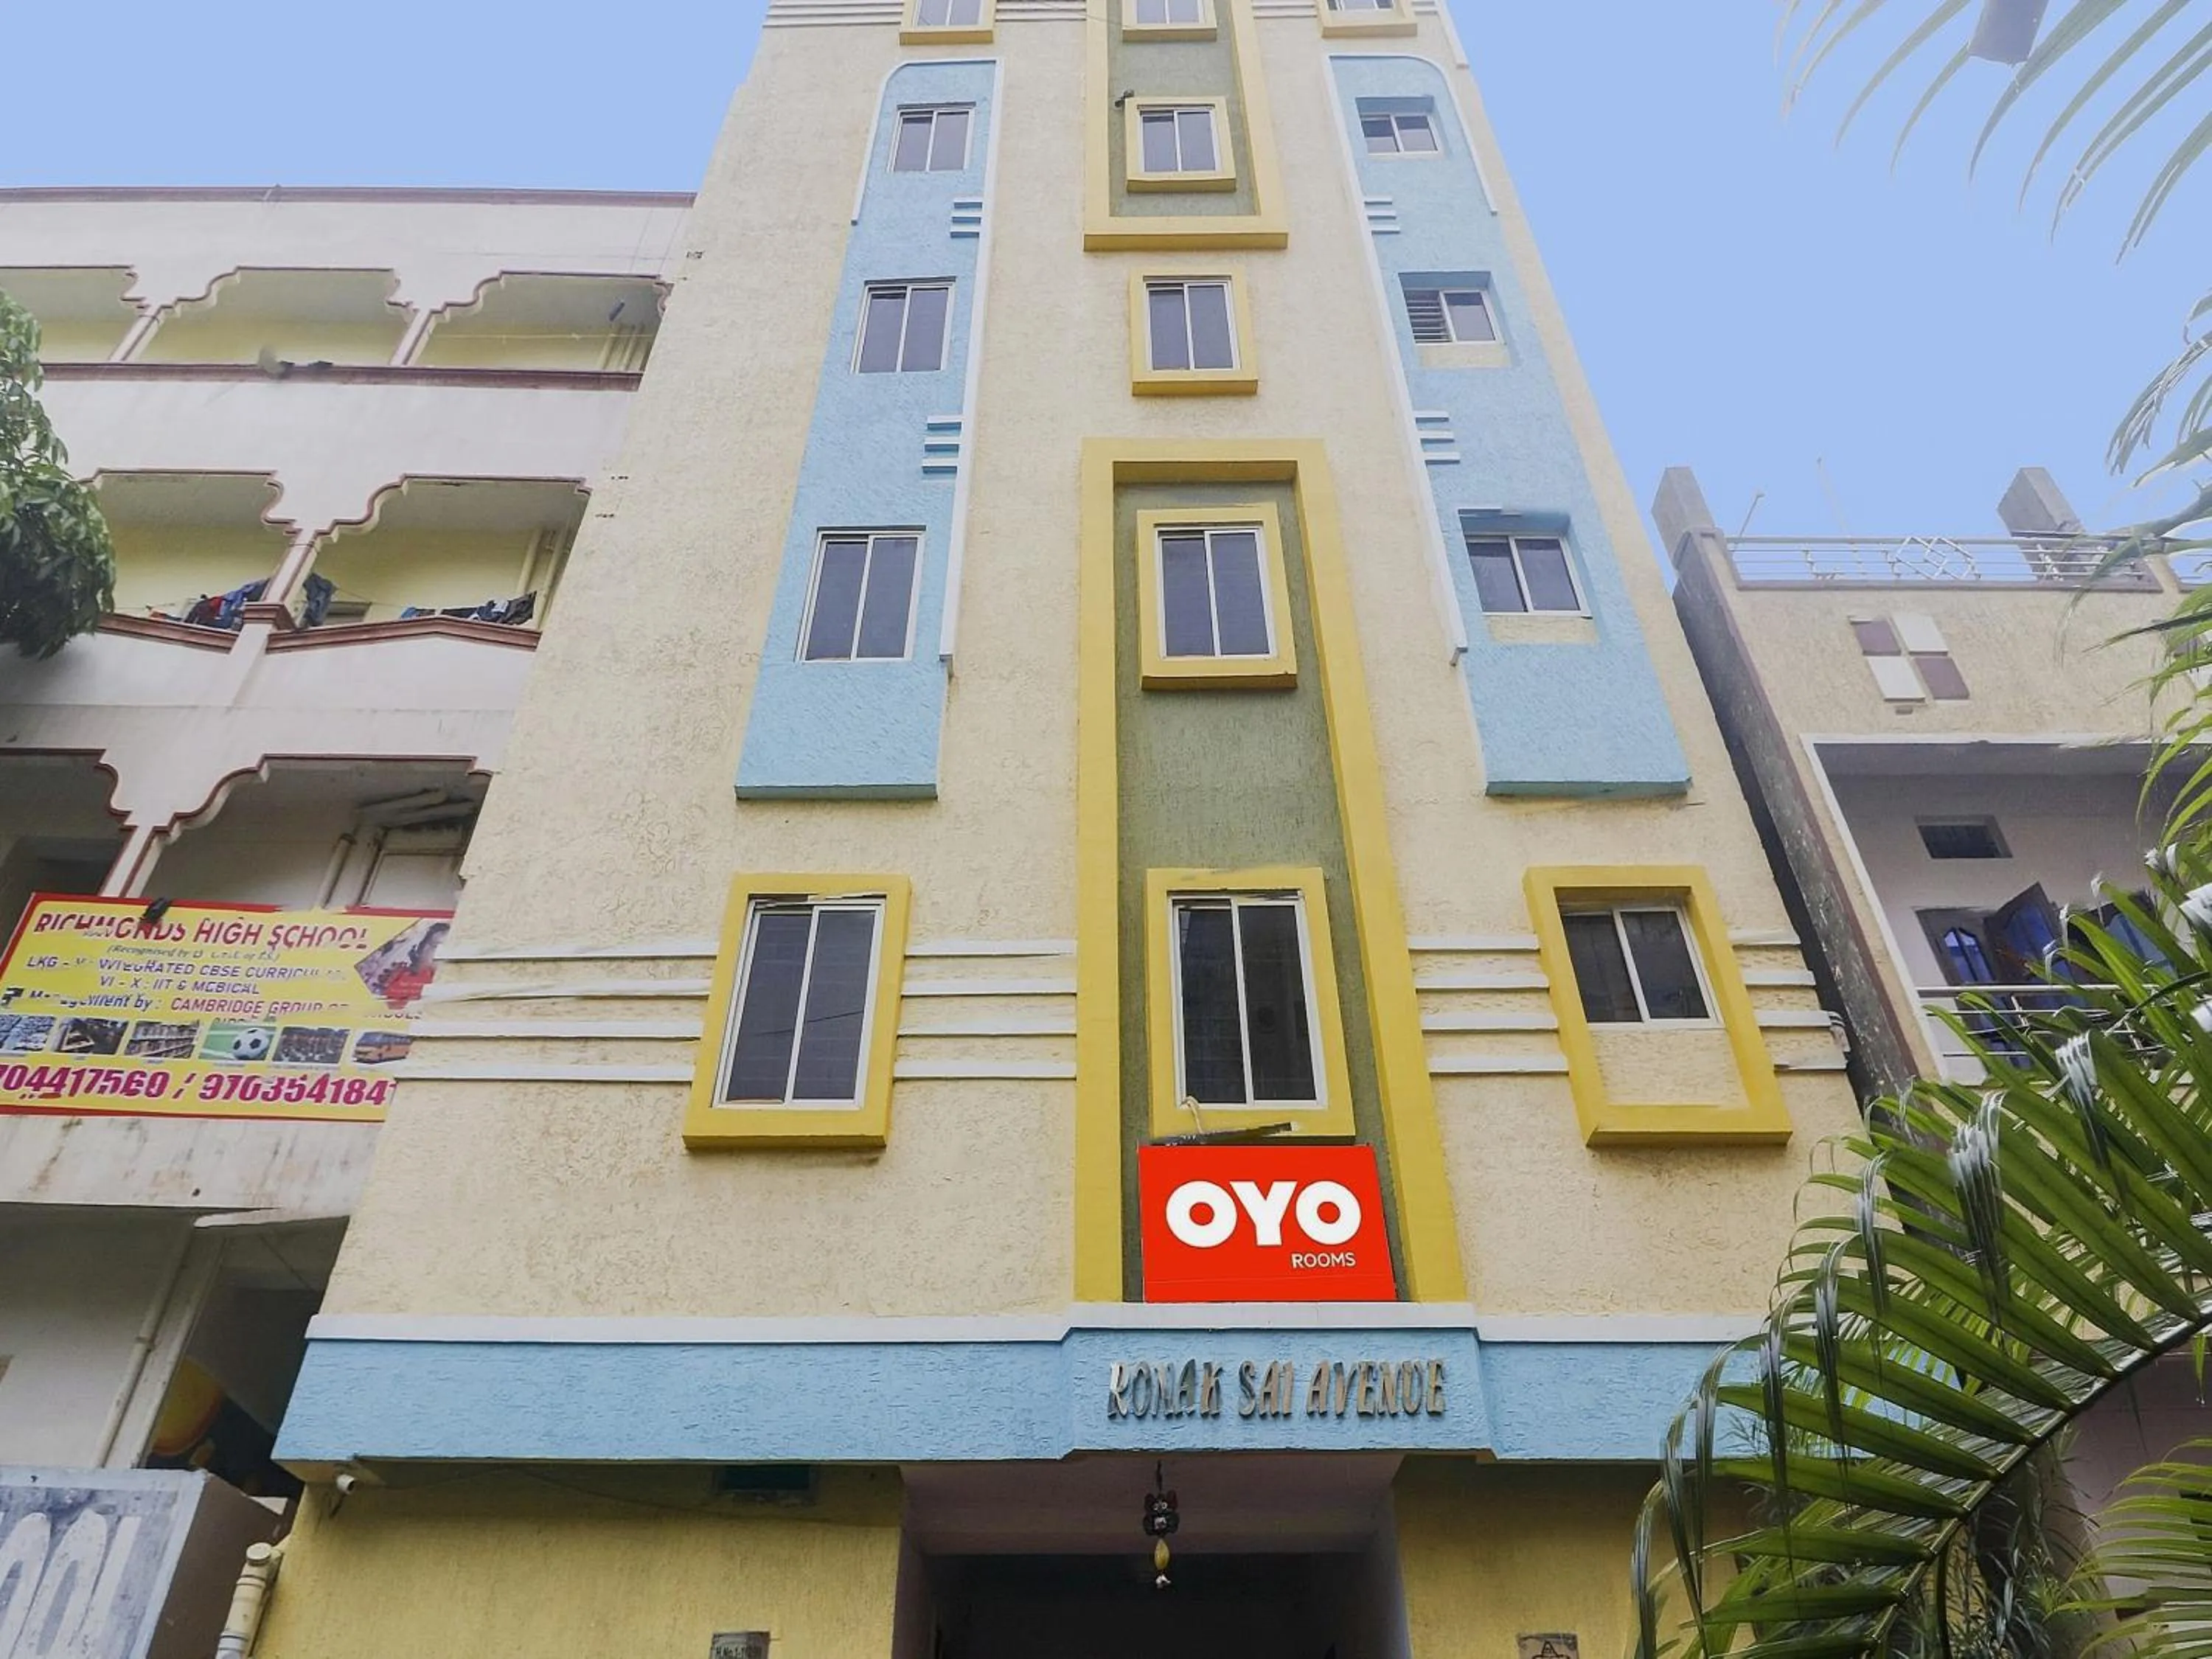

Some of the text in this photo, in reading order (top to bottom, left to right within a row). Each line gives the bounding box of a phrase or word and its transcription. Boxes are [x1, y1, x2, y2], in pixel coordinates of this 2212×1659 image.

[192, 919, 262, 946] HIGH
[27, 956, 58, 970] LKG
[170, 998, 265, 1015] CAMBRIDGE
[199, 1073, 398, 1105] 970354184
[1166, 1180, 1362, 1248] OYO
[1291, 1251, 1357, 1269] ROOMS
[1107, 1358, 1447, 1418] RONAK SAI AVENUE
